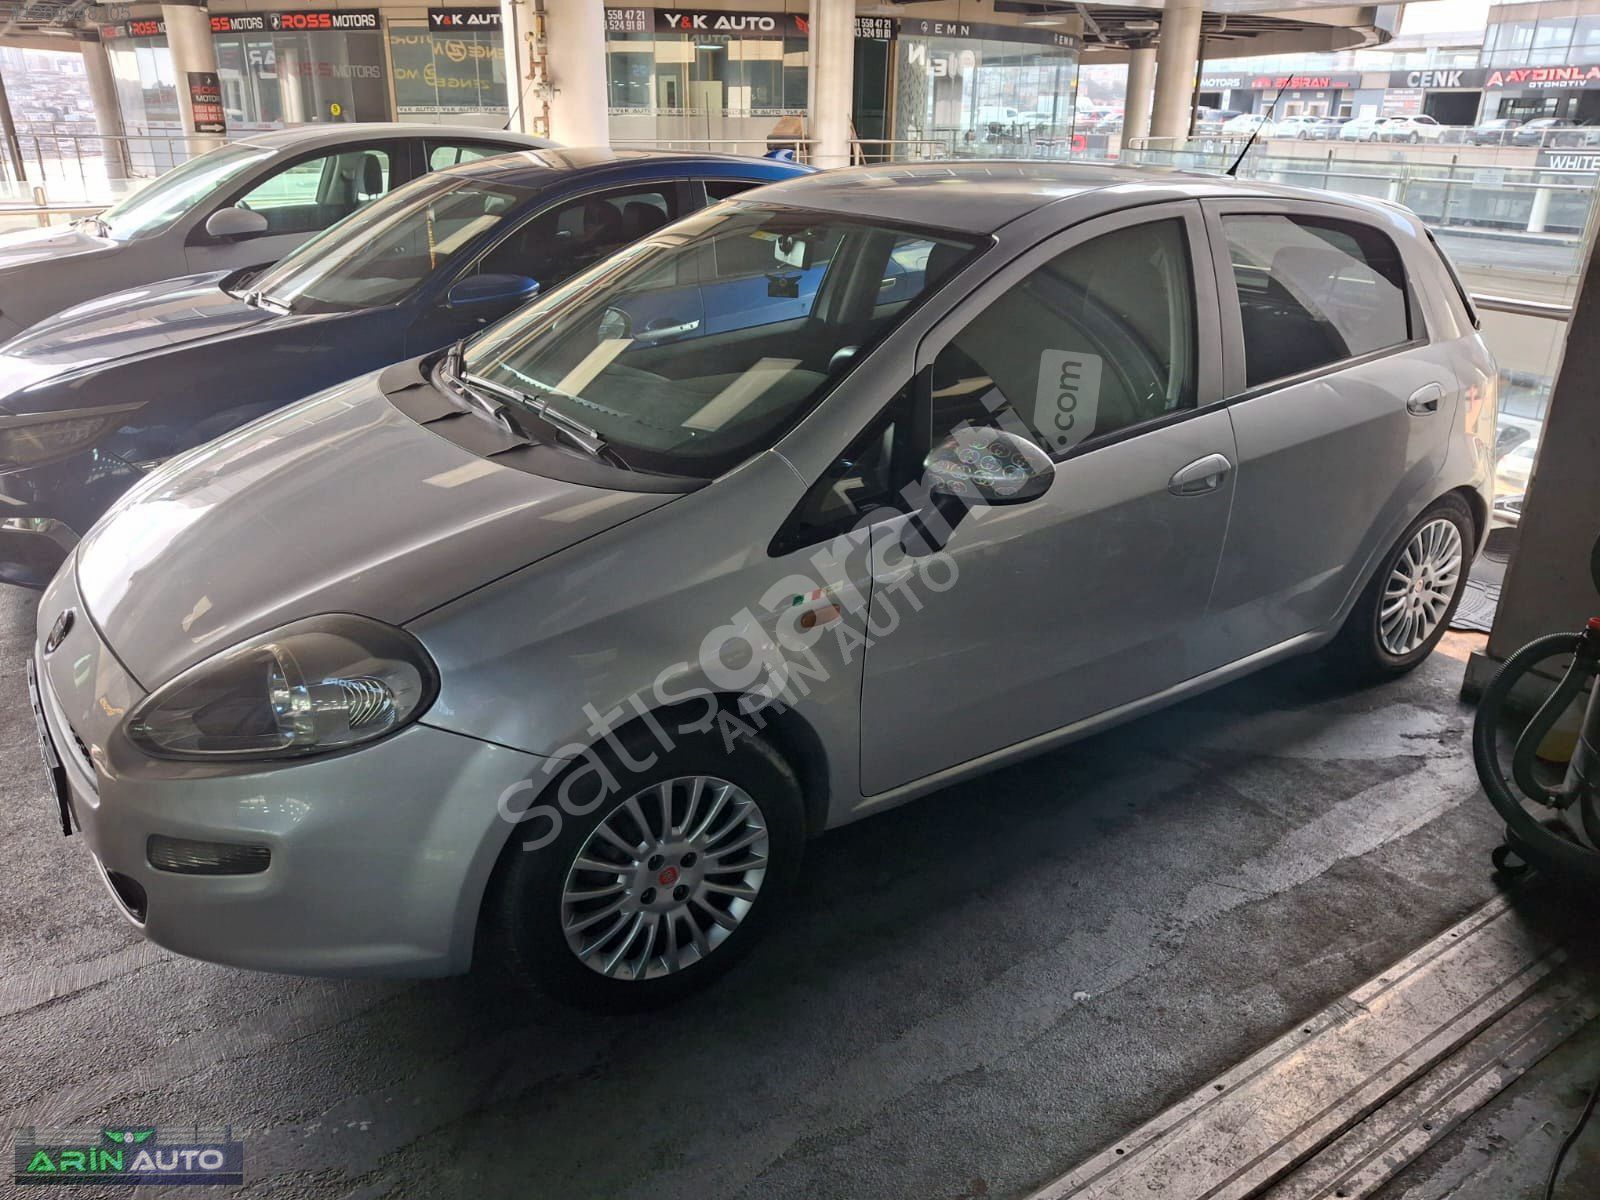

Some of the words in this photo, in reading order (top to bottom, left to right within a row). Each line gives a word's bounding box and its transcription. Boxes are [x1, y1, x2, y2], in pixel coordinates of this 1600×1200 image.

[281, 13, 331, 28] ROSS
[332, 14, 376, 27] MOTORS
[432, 14, 463, 24] Y&K
[608, 10, 623, 20] 558
[625, 11, 634, 20] 47
[636, 11, 645, 20] 21
[664, 14, 708, 29] Y&K
[714, 16, 775, 30] AUTO
[133, 21, 158, 35] ROSS
[209, 17, 230, 31] SS
[231, 17, 263, 30] MOTORS
[609, 21, 624, 31] 524
[626, 21, 635, 30] 91
[875, 18, 883, 28] 47
[884, 18, 892, 28] 21
[934, 23, 970, 36] EMN
[333, 64, 381, 79] MOTORS
[1200, 78, 1241, 88] MOTORS
[1407, 71, 1464, 88] CENK
[1550, 155, 1600, 169] WHITE
